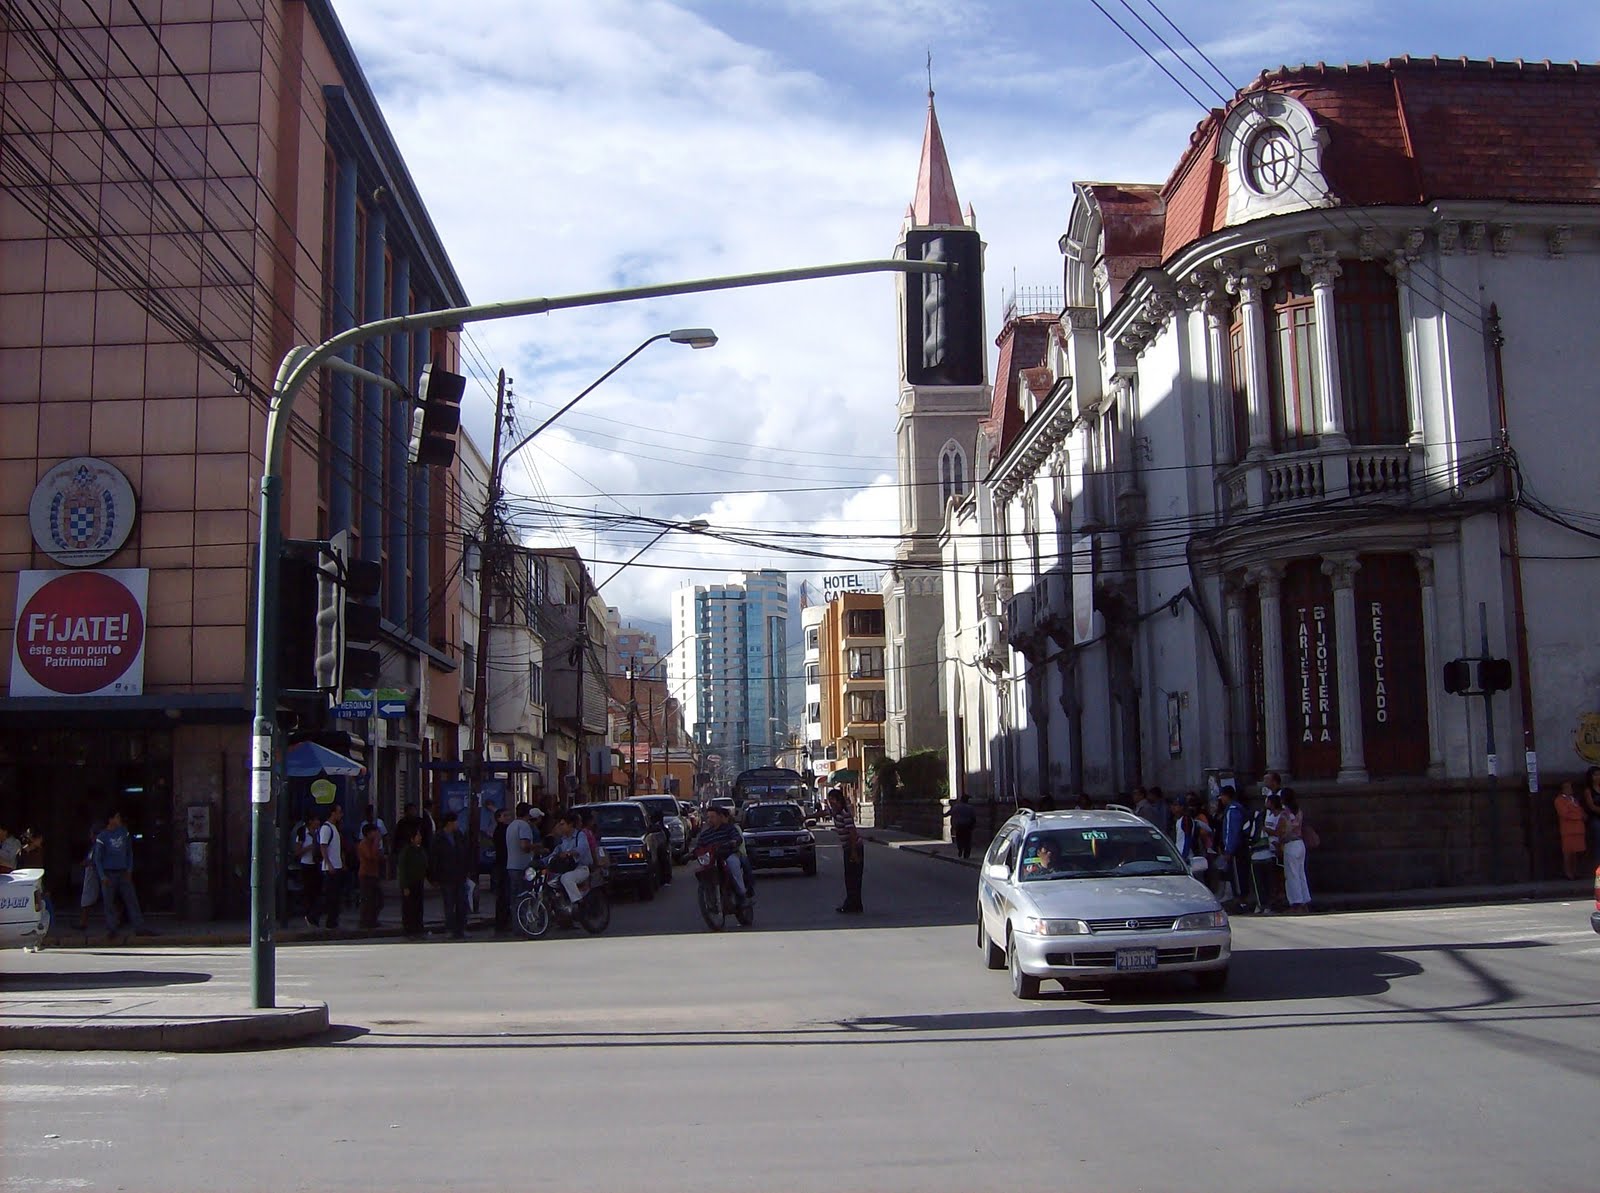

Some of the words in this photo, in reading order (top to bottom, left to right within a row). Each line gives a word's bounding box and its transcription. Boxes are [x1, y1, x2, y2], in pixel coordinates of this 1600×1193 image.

[824, 575, 863, 589] HOTEL
[29, 644, 52, 655] éste
[55, 646, 68, 655] es
[70, 645, 84, 655] un
[45, 656, 107, 667] Patrimonial
[1371, 602, 1387, 723] RECICLADO
[1298, 608, 1313, 742] TARJETERIA
[1313, 606, 1331, 742] BIJOUTERIA
[1084, 831, 1107, 840] TAXI
